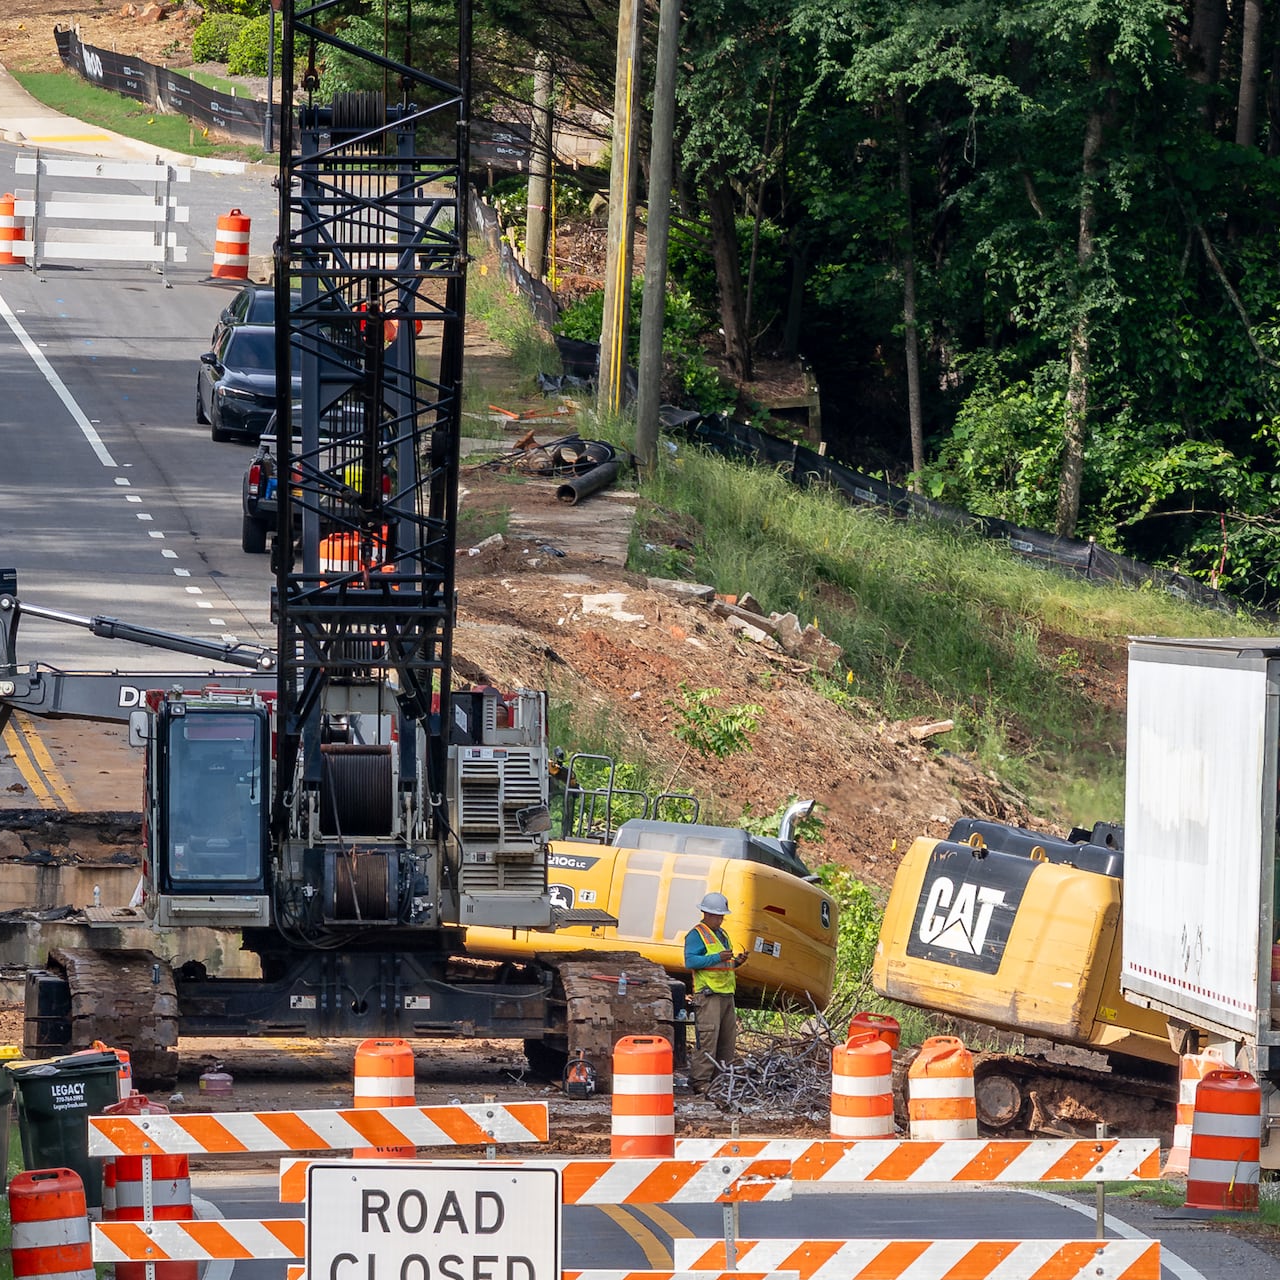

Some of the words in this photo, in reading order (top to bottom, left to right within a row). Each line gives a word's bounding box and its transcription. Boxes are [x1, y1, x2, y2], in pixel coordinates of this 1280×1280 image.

[919, 876, 1006, 956] CAT
[51, 1082, 86, 1097] LEGACY
[360, 1188, 505, 1235] ROAD
